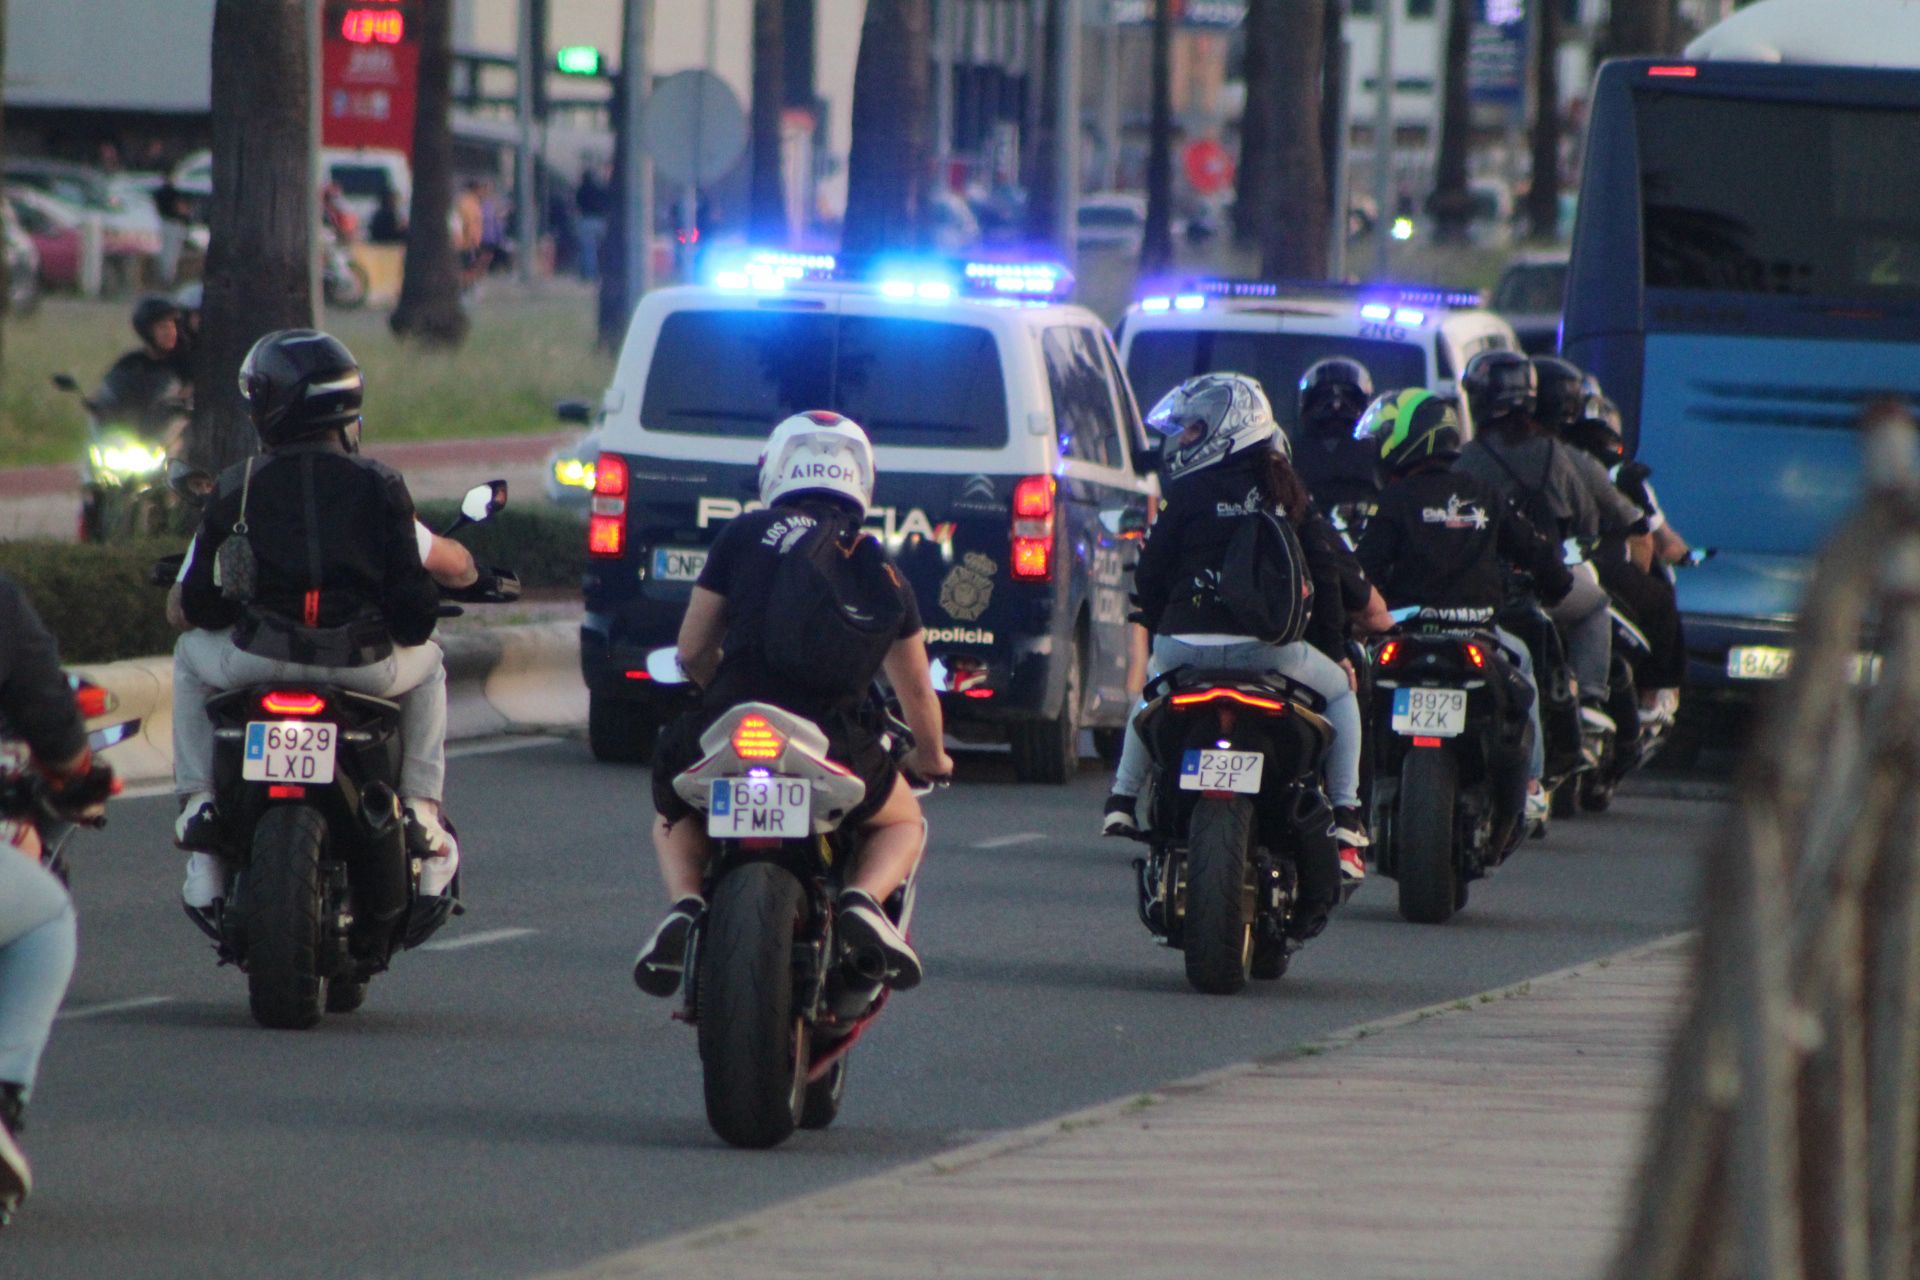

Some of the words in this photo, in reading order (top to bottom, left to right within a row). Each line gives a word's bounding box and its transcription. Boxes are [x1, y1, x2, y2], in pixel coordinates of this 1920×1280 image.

[791, 463, 854, 481] AIROH
[761, 521, 788, 546] LOS
[1412, 692, 1463, 711] 8979
[1411, 711, 1447, 728] KZK
[268, 726, 330, 751] 6929
[265, 754, 316, 779] LXD
[1201, 754, 1259, 771] 2307
[1199, 771, 1242, 788] LZF
[734, 783, 805, 806] 6310
[732, 808, 785, 832] FMR
